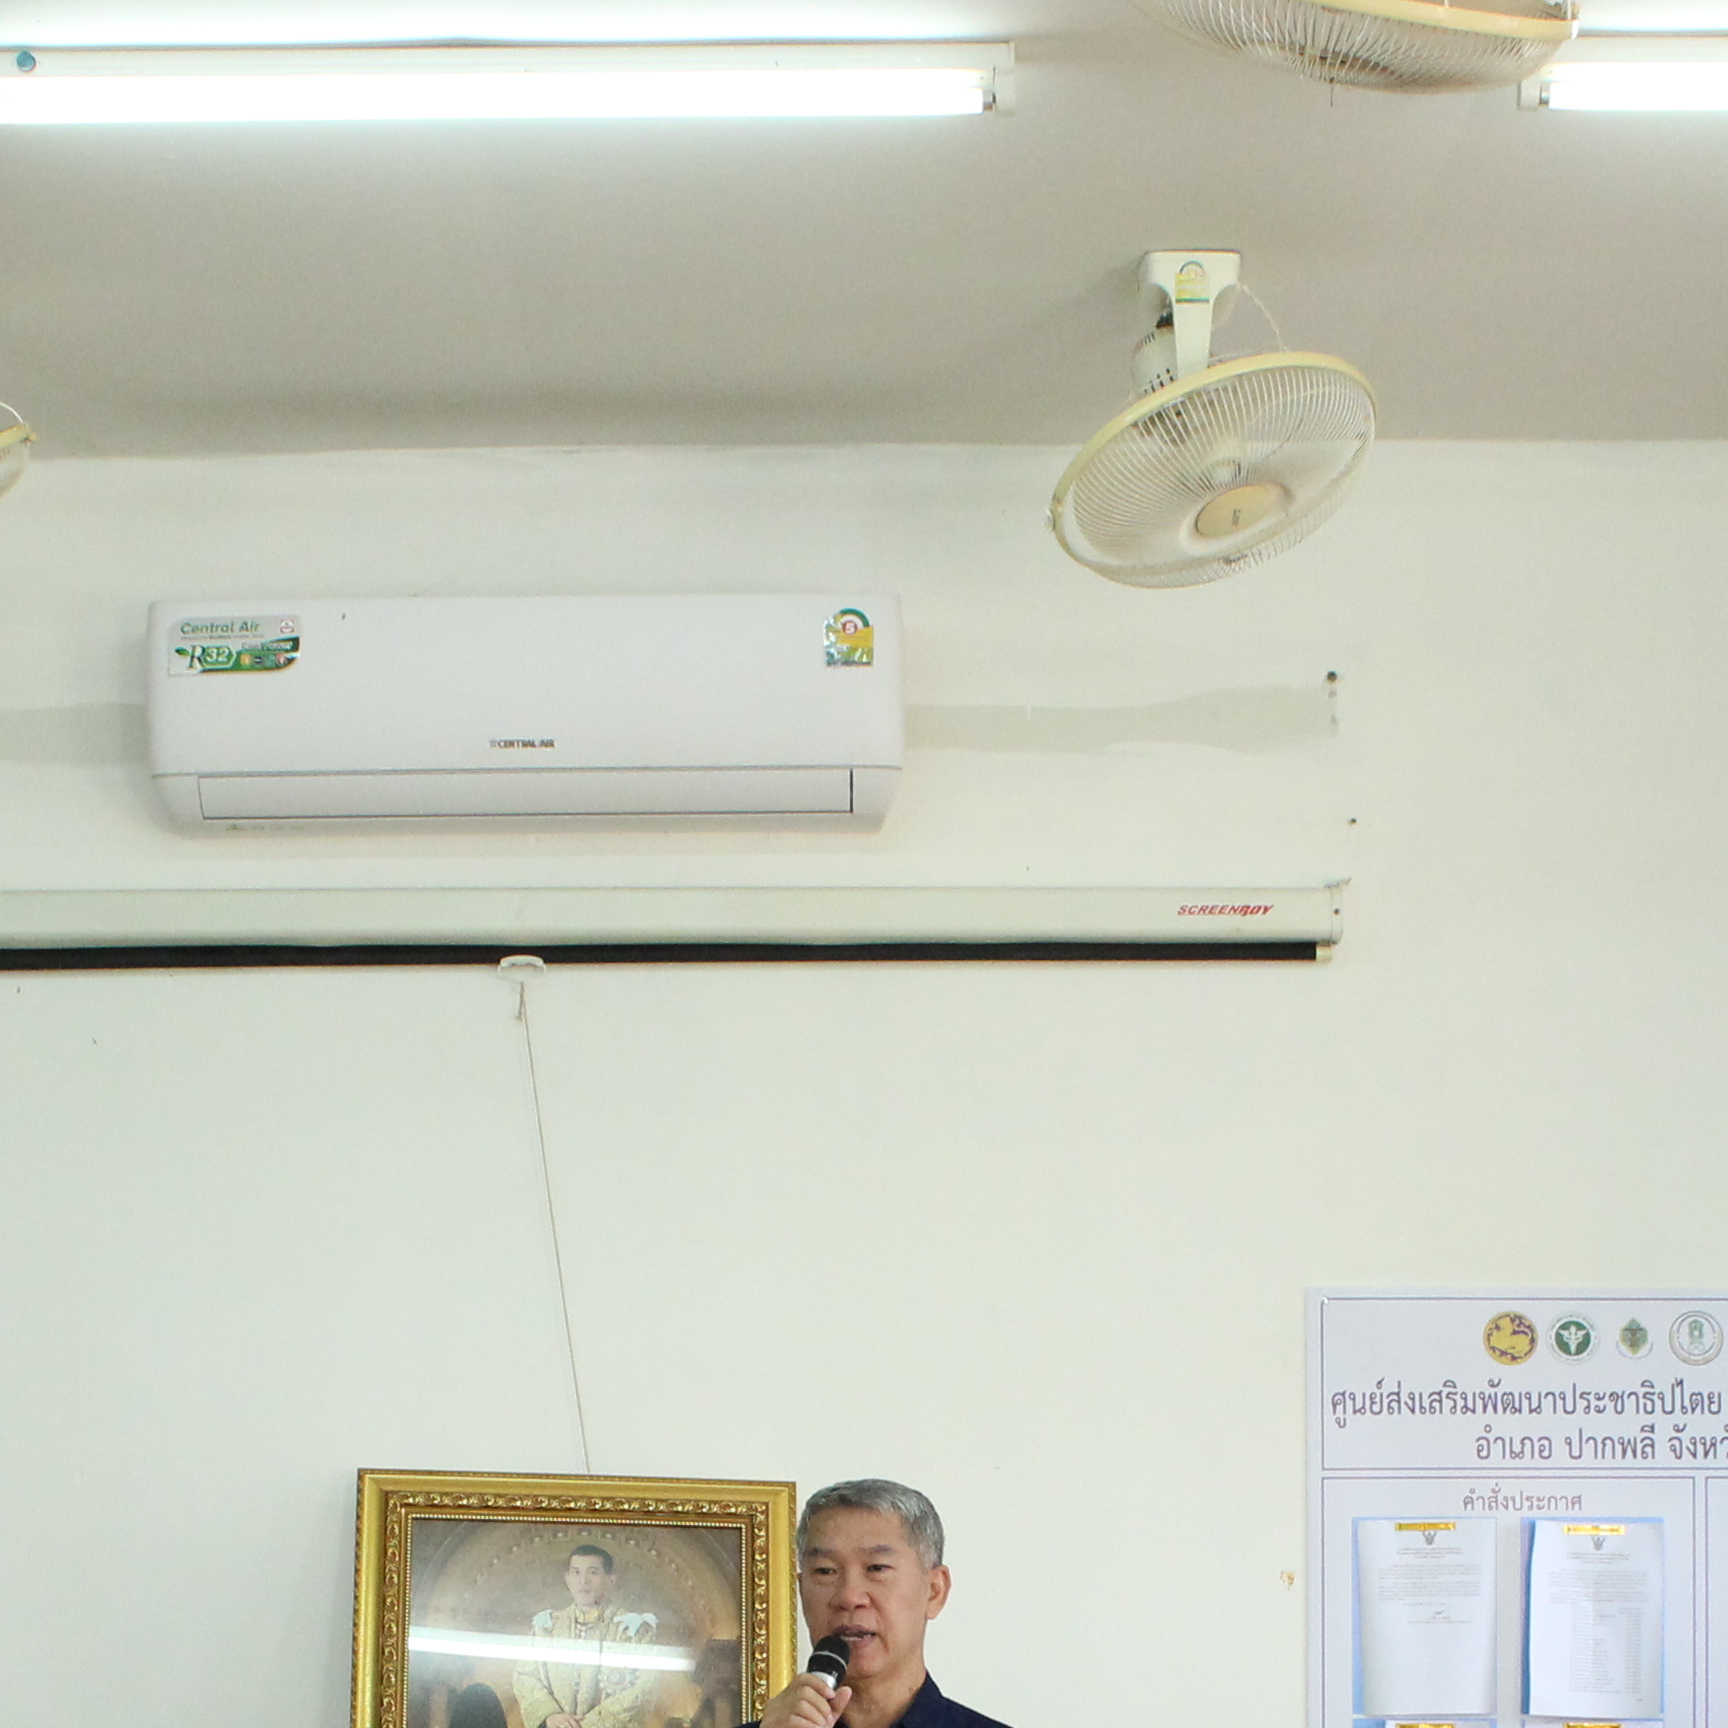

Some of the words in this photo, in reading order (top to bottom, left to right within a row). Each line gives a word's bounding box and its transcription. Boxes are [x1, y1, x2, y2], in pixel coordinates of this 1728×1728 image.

[180, 621, 234, 635] Central
[238, 620, 261, 633] Air
[1330, 1376, 1723, 1430] ศูนย์ส่งเสริมพัฒนาประชาธิปไตย
[1474, 1424, 1554, 1461] อำเภอ
[1563, 1423, 1657, 1461] ปากพลี
[1461, 1481, 1583, 1513] คำสั่งประกาศ
